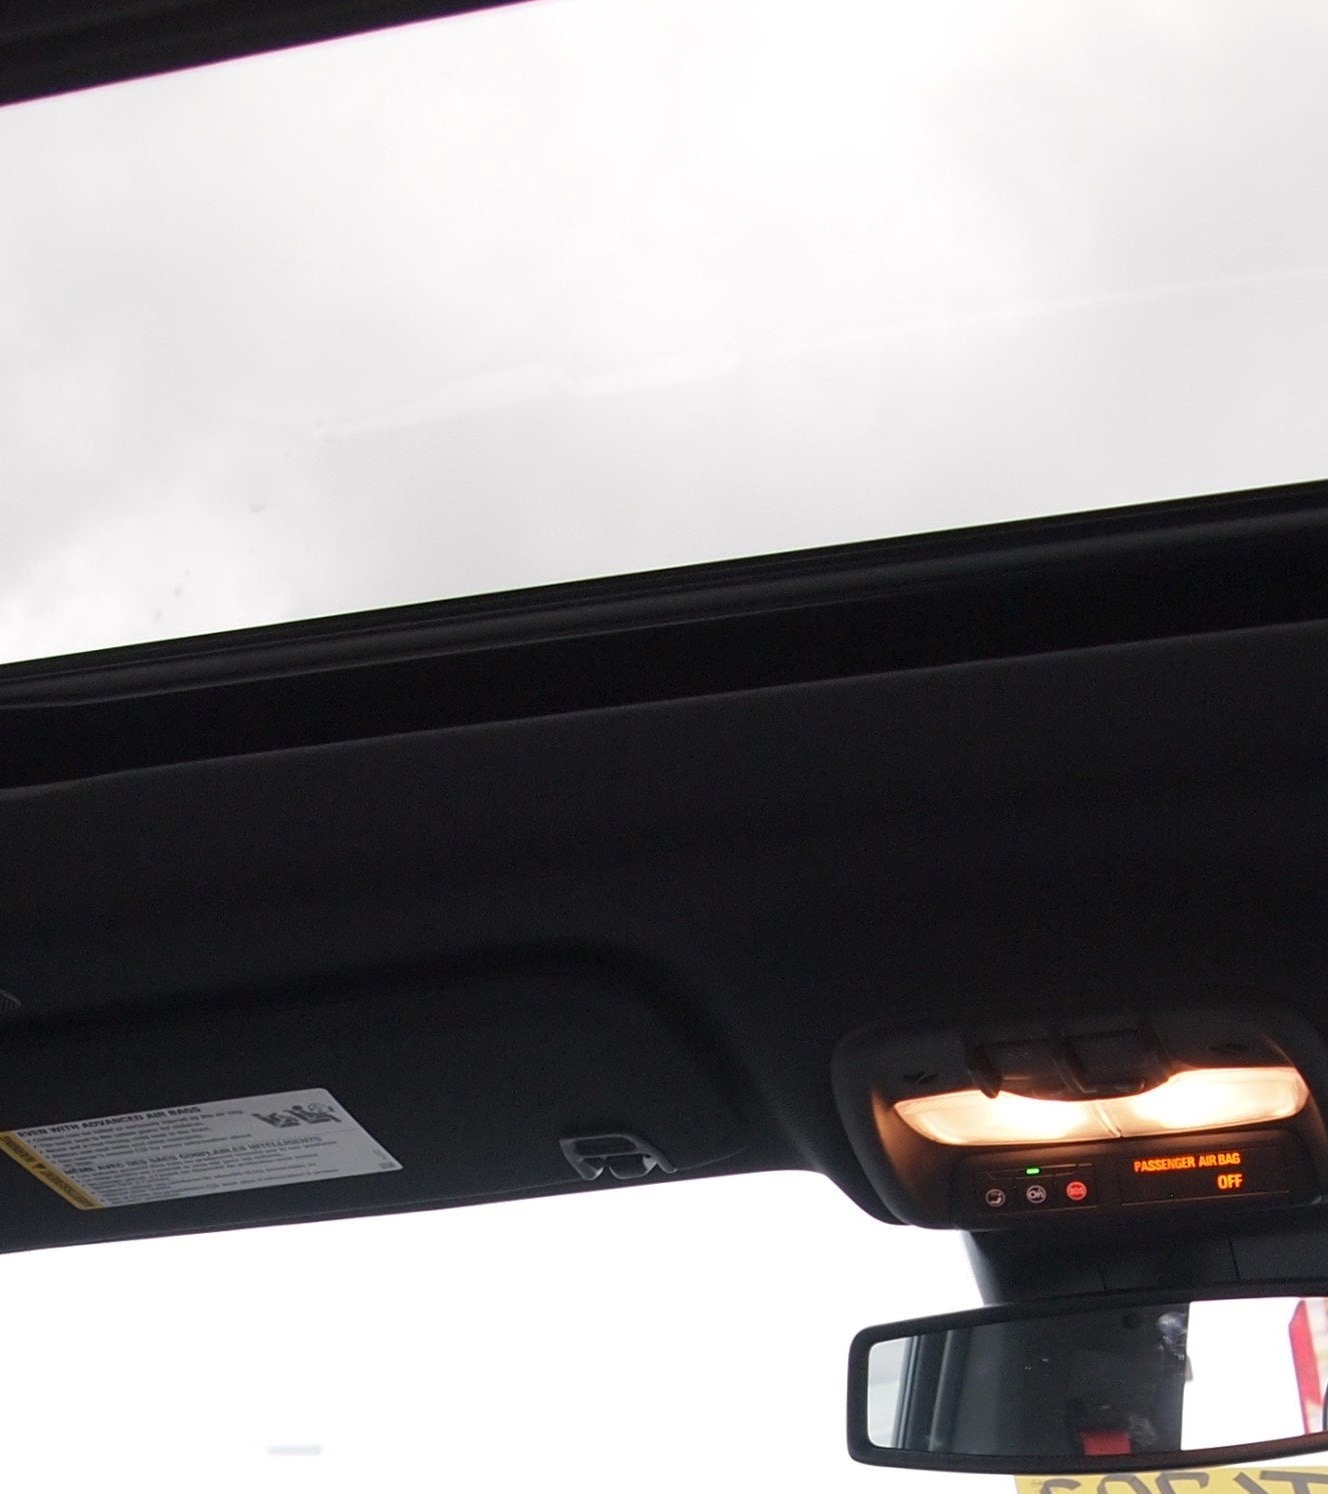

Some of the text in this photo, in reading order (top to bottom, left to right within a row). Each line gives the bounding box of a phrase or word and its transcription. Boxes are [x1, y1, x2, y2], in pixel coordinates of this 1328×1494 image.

[1134, 1152, 1240, 1173] PASSENGER AIR BAG
[1217, 1173, 1244, 1190] OFF
